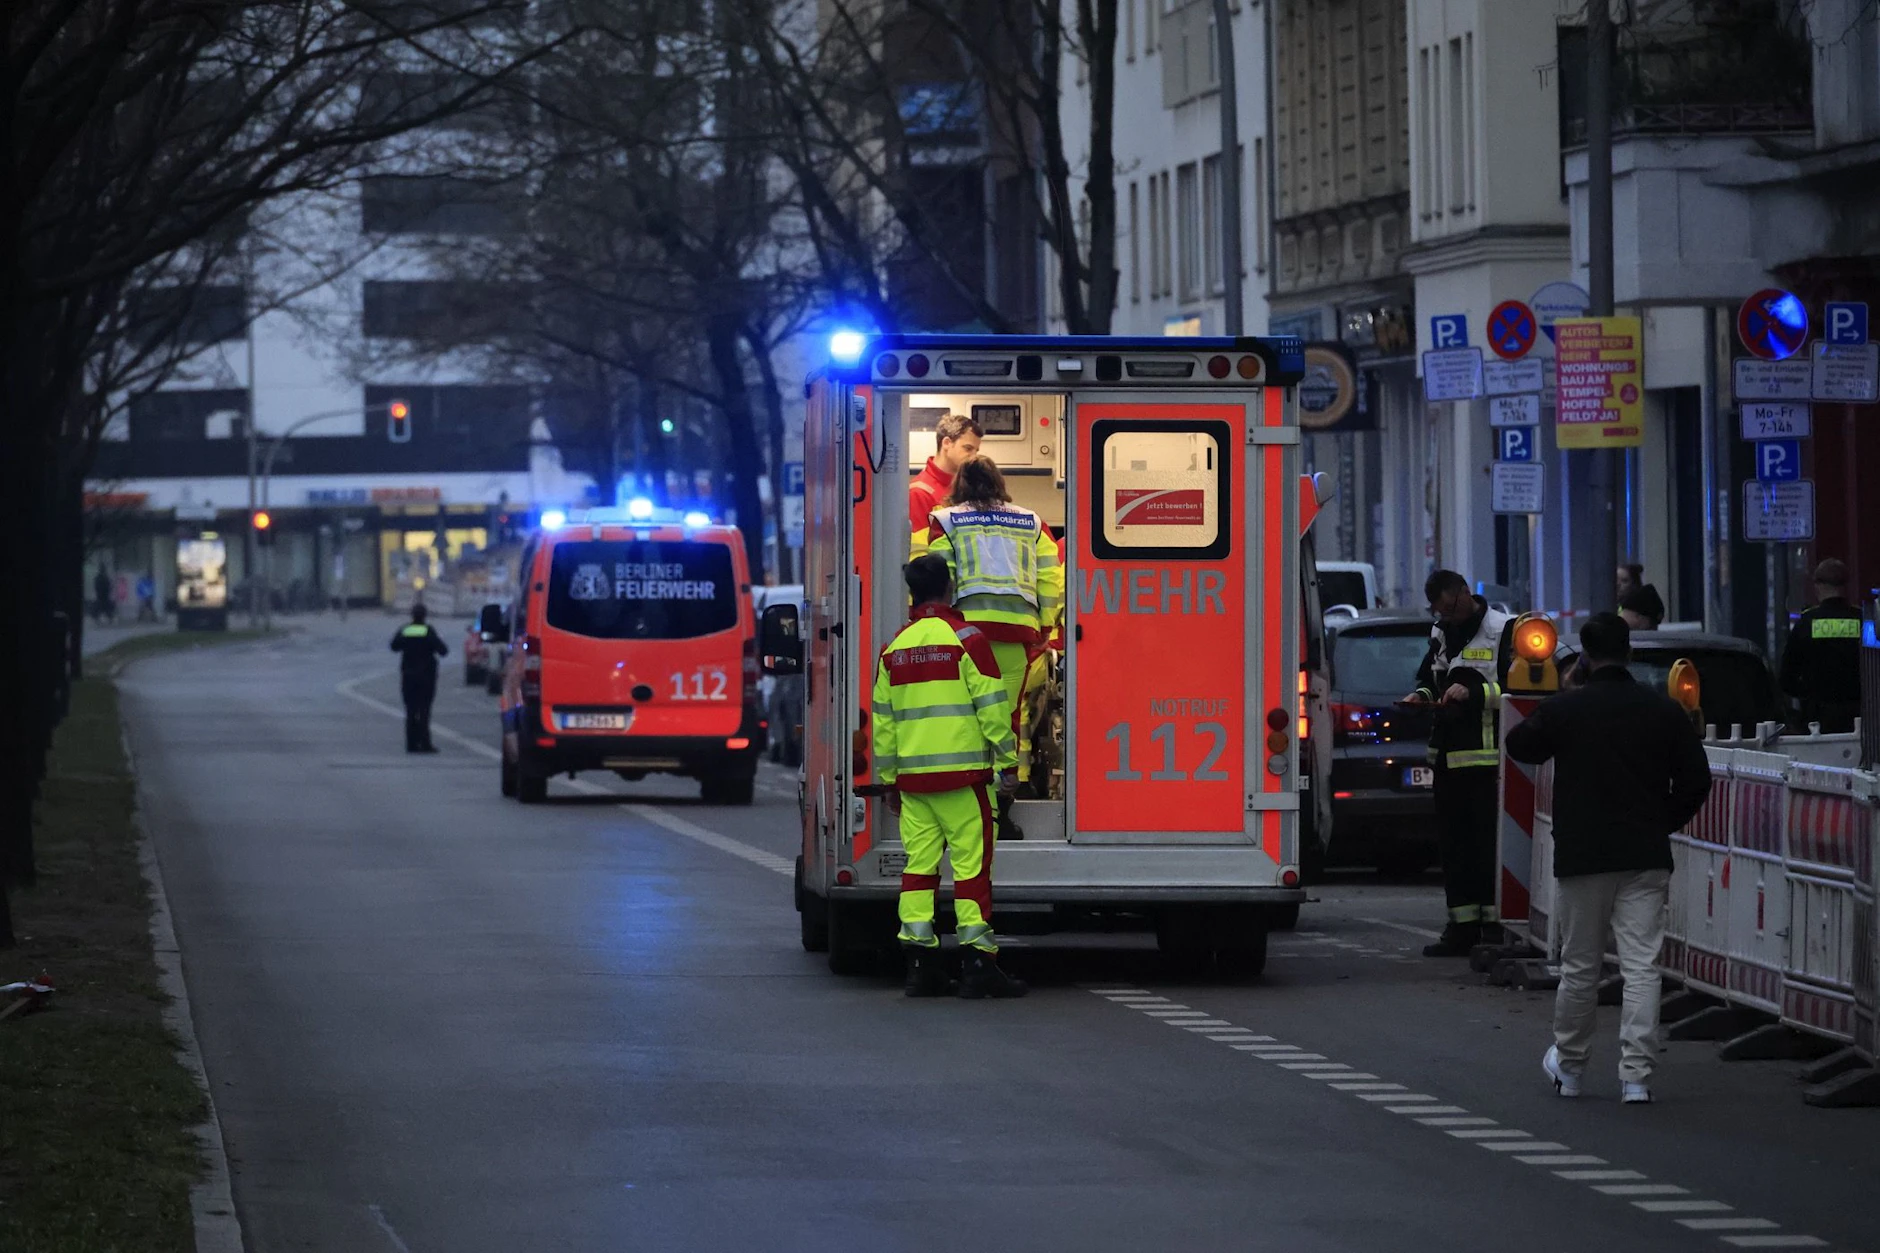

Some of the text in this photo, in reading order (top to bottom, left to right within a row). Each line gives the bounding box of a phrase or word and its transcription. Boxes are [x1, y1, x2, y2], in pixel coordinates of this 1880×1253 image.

[1832, 307, 1855, 341] P
[1436, 319, 1457, 348] P
[1560, 326, 1600, 338] AUTOS
[1560, 337, 1630, 350] VERBIETEN?
[1560, 350, 1592, 362] NEIN!
[1560, 362, 1634, 374] WOHNUNGS-
[1560, 374, 1607, 386] BAU AM
[1561, 386, 1613, 398] TEMPEL-
[1561, 398, 1602, 410] HOFER
[1561, 409, 1619, 422] FELD? JA!
[1755, 407, 1795, 419] Mo-Fr
[1759, 421, 1793, 434] 7-14h
[1505, 429, 1524, 459] P
[1763, 444, 1787, 478] P
[1165, 502, 1198, 510] bewerben
[951, 514, 1035, 527] Leitende Notärztin
[614, 562, 684, 579] BERLINER
[614, 580, 716, 600] FEUERWEHR
[1076, 568, 1227, 615] WEHR
[1813, 620, 1859, 636] POLIZEI
[670, 671, 728, 701] 112
[1150, 698, 1230, 717] NOTRUF
[1105, 721, 1229, 782] 112
[1413, 769, 1422, 783] B
